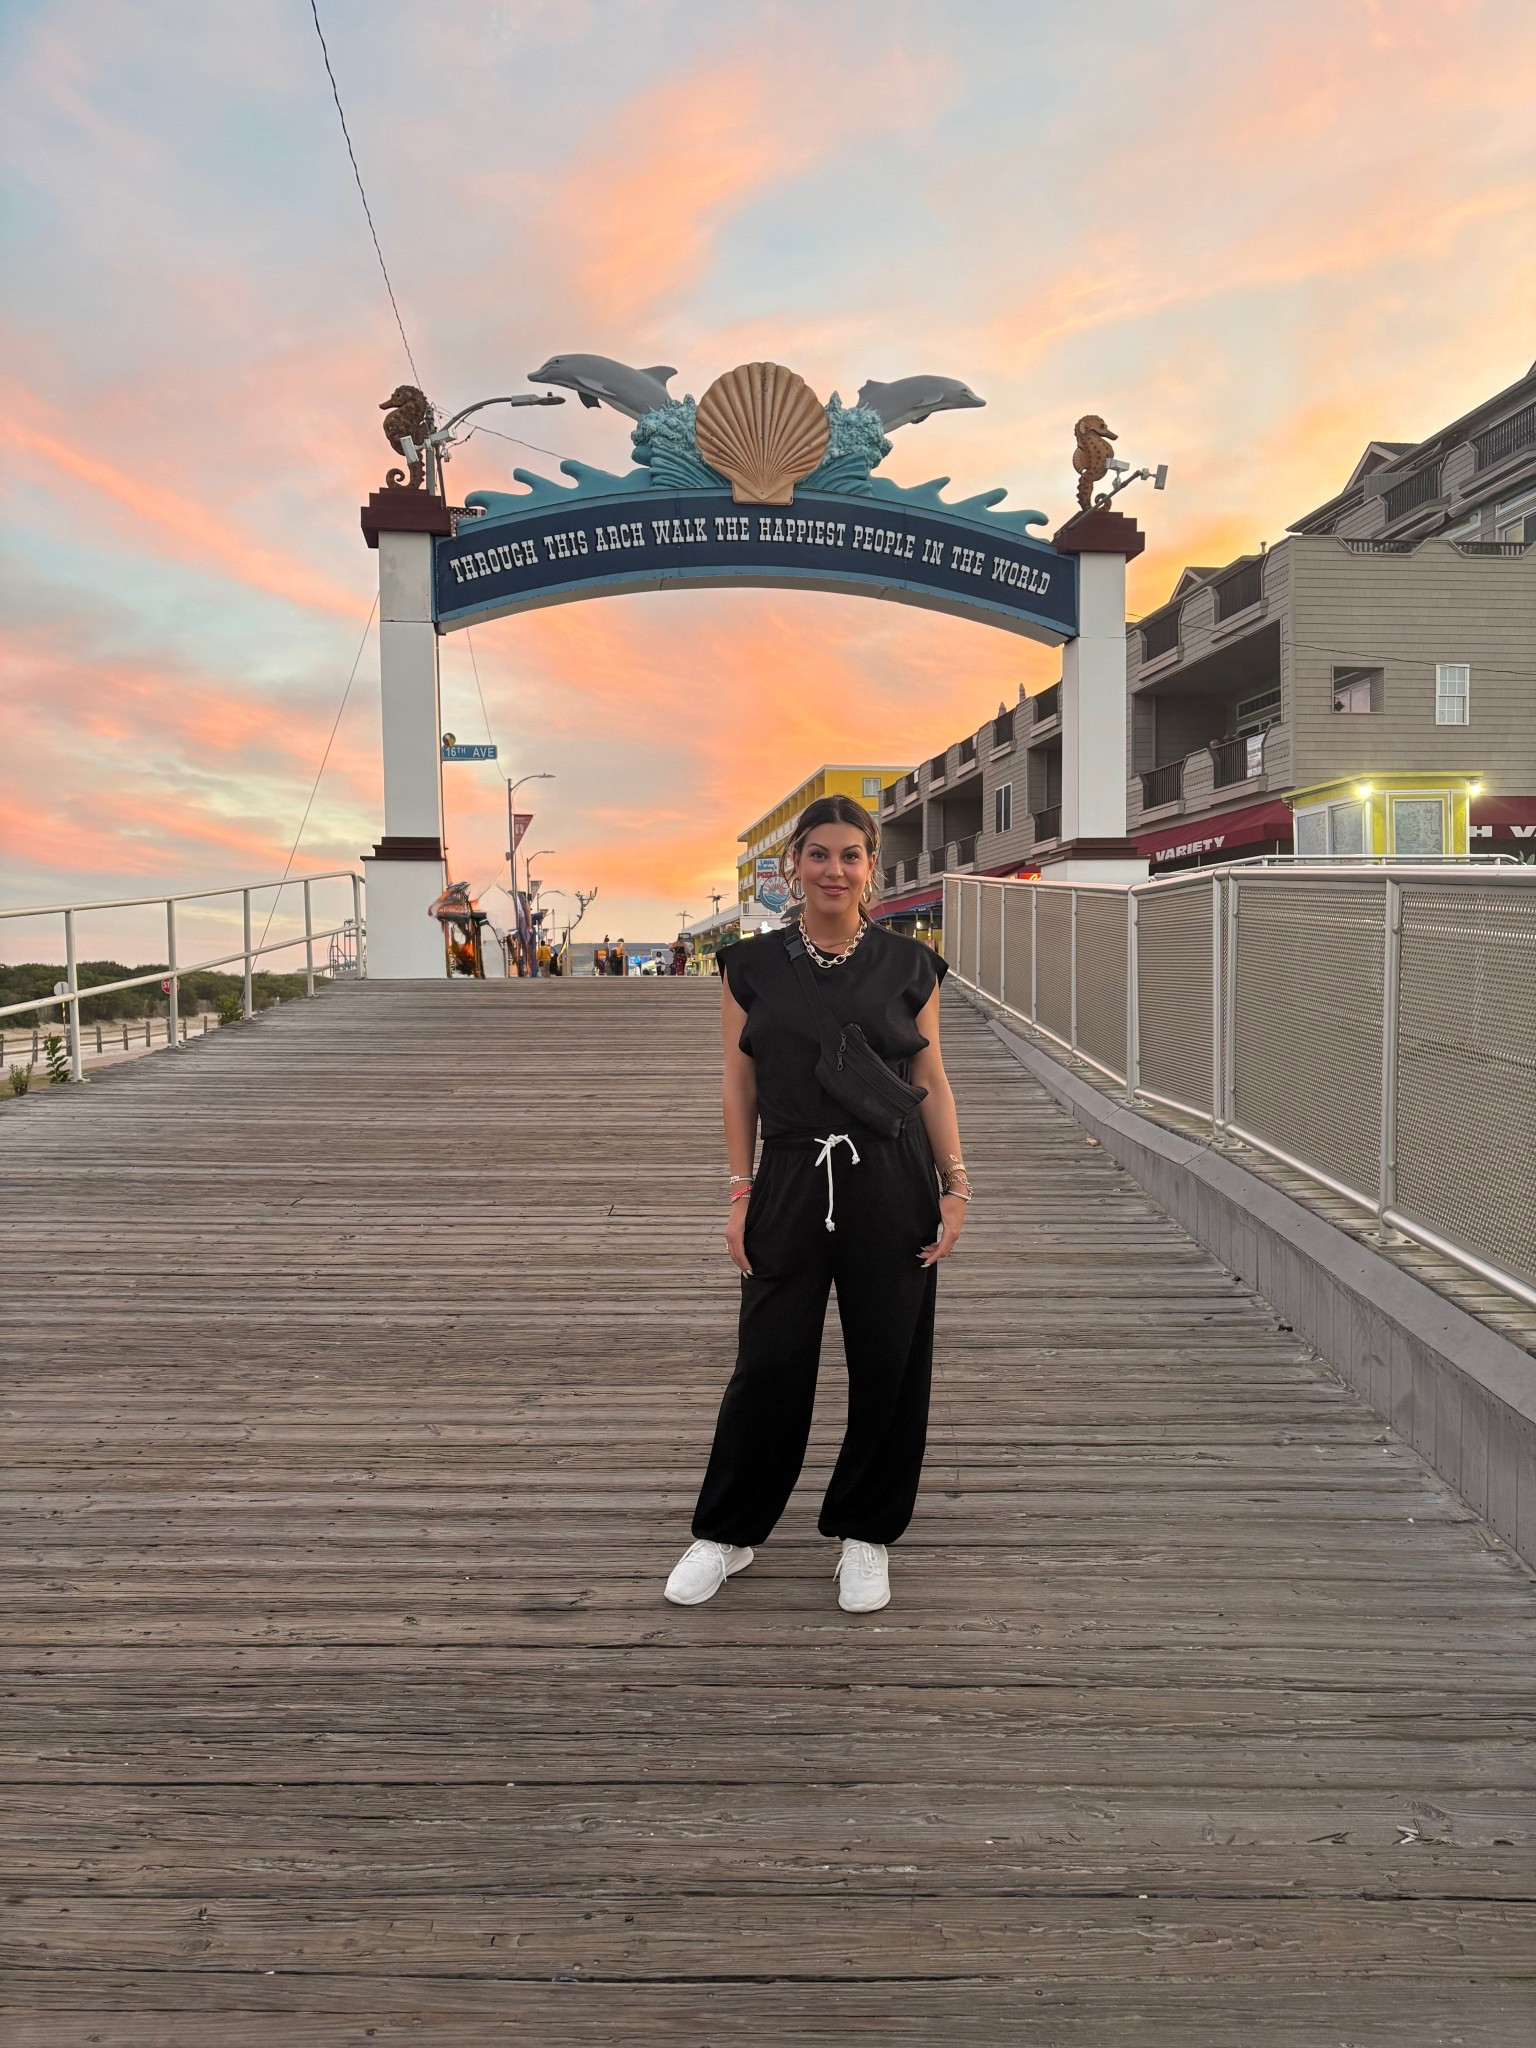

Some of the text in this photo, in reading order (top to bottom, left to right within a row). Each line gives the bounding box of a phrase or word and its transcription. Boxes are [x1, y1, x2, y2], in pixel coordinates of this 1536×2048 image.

[450, 517, 1051, 595] THROUGH THIS ARCH WALK THE HAPPIEST PEOPLE IN THE WORLD
[446, 747, 494, 758] 16TH AVE
[1155, 835, 1226, 862] VARIETY
